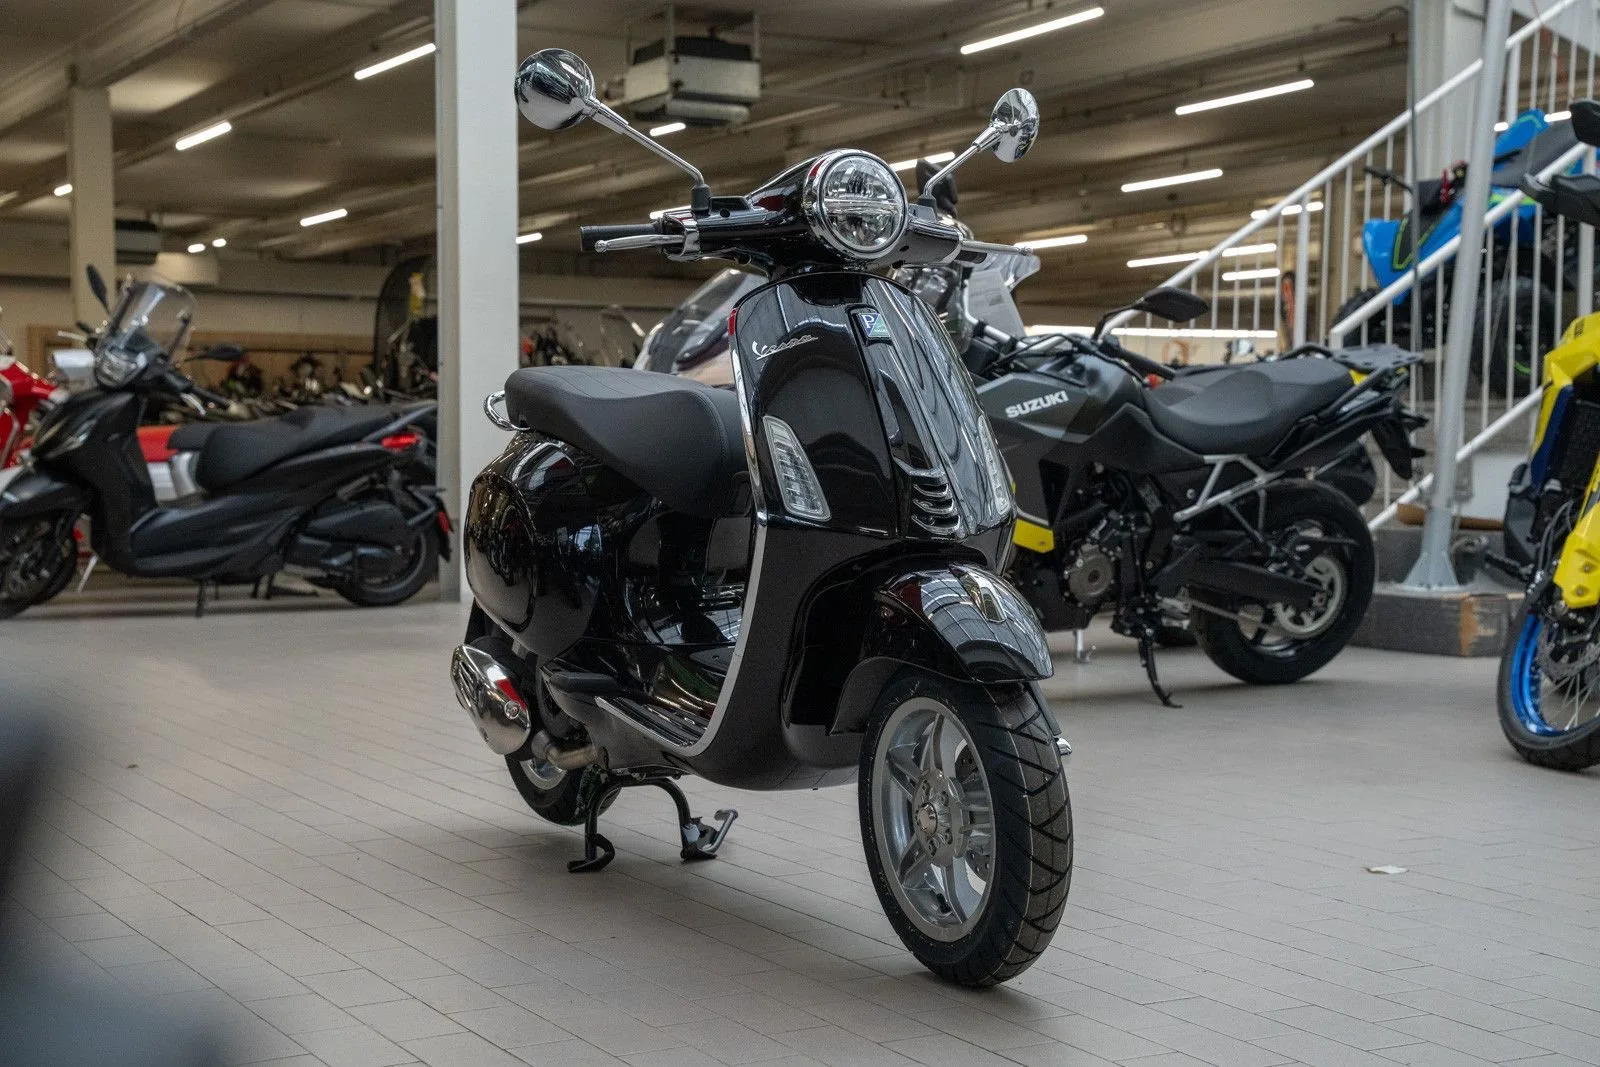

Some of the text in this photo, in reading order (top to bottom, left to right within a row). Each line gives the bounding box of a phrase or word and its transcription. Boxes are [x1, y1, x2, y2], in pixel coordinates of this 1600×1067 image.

[861, 314, 875, 329] P
[751, 335, 819, 361] Vespa
[1004, 390, 1069, 418] SUZUKI
